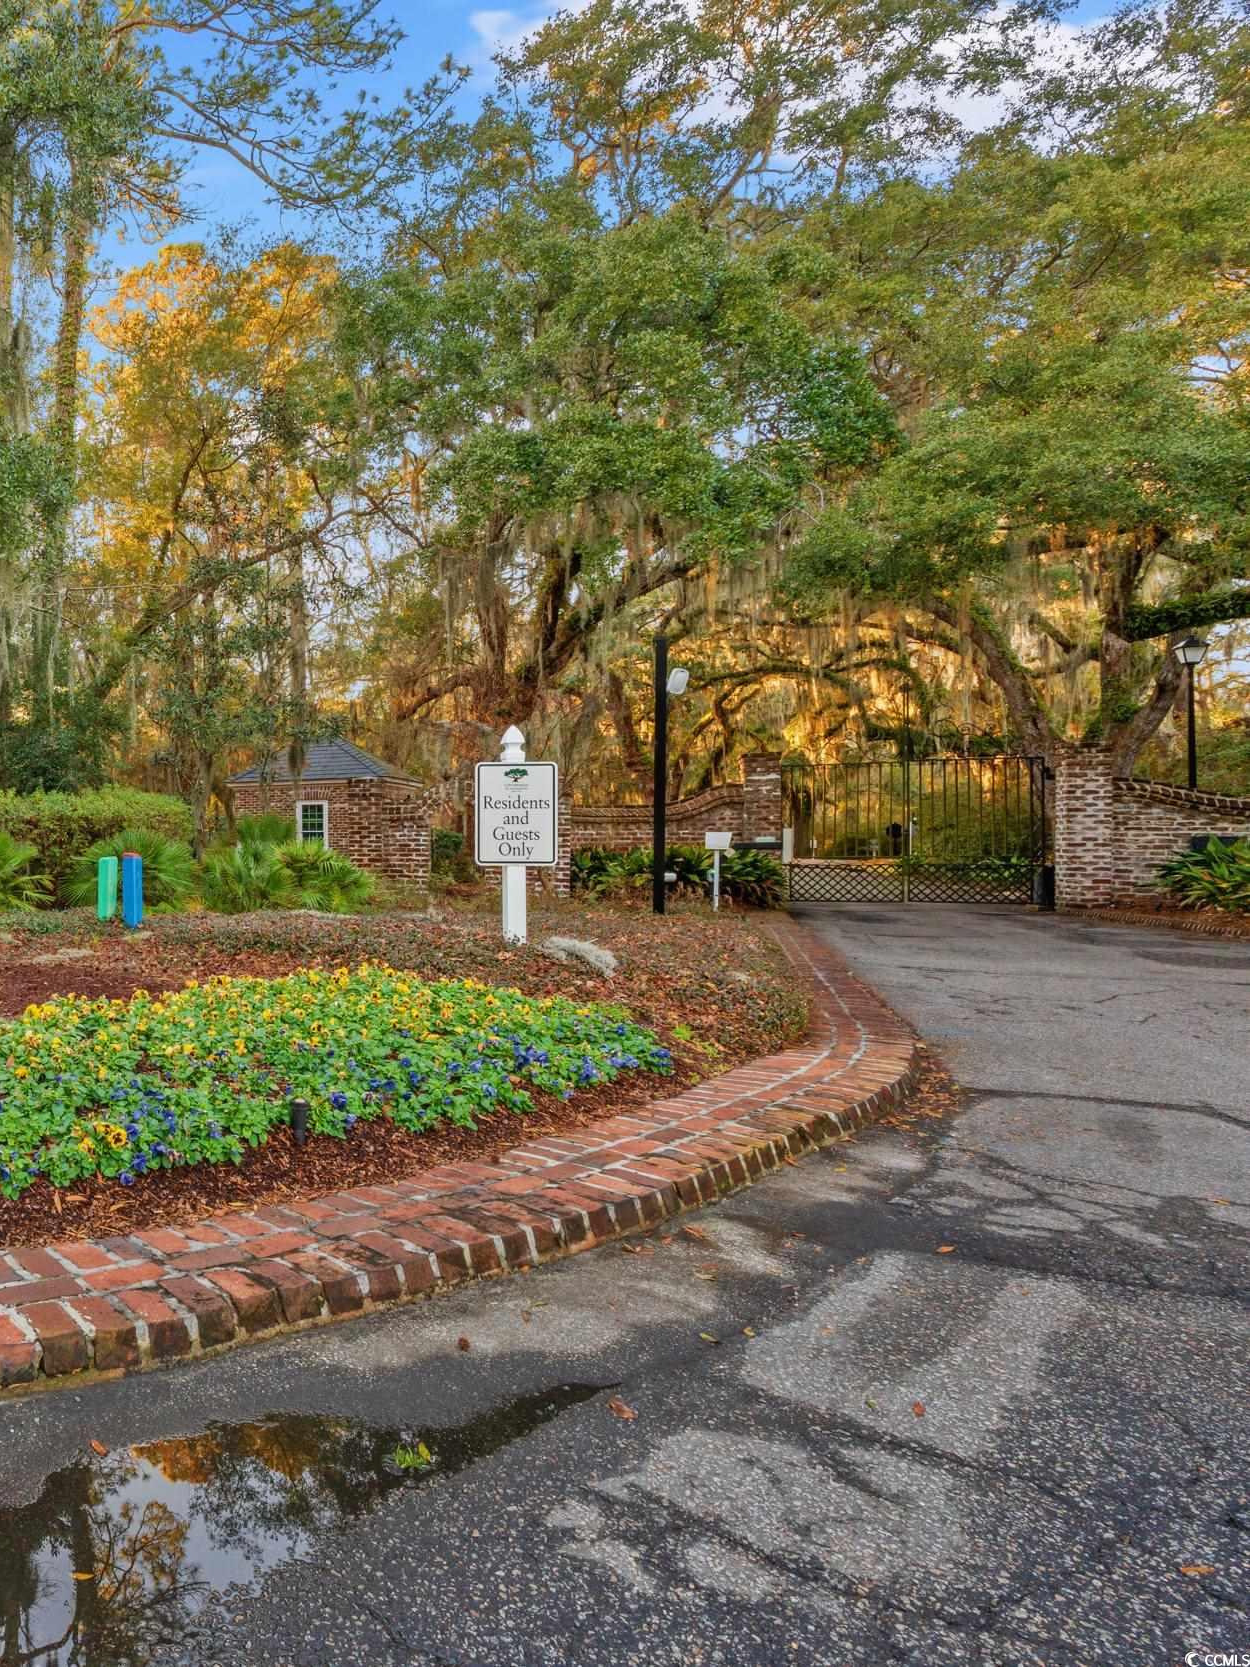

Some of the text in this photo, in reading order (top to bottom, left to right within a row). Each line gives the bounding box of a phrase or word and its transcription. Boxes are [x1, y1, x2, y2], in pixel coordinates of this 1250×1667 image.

[483, 795, 550, 810] Residents
[503, 811, 529, 825] and
[493, 827, 541, 841] Guests
[498, 842, 534, 860] Only
